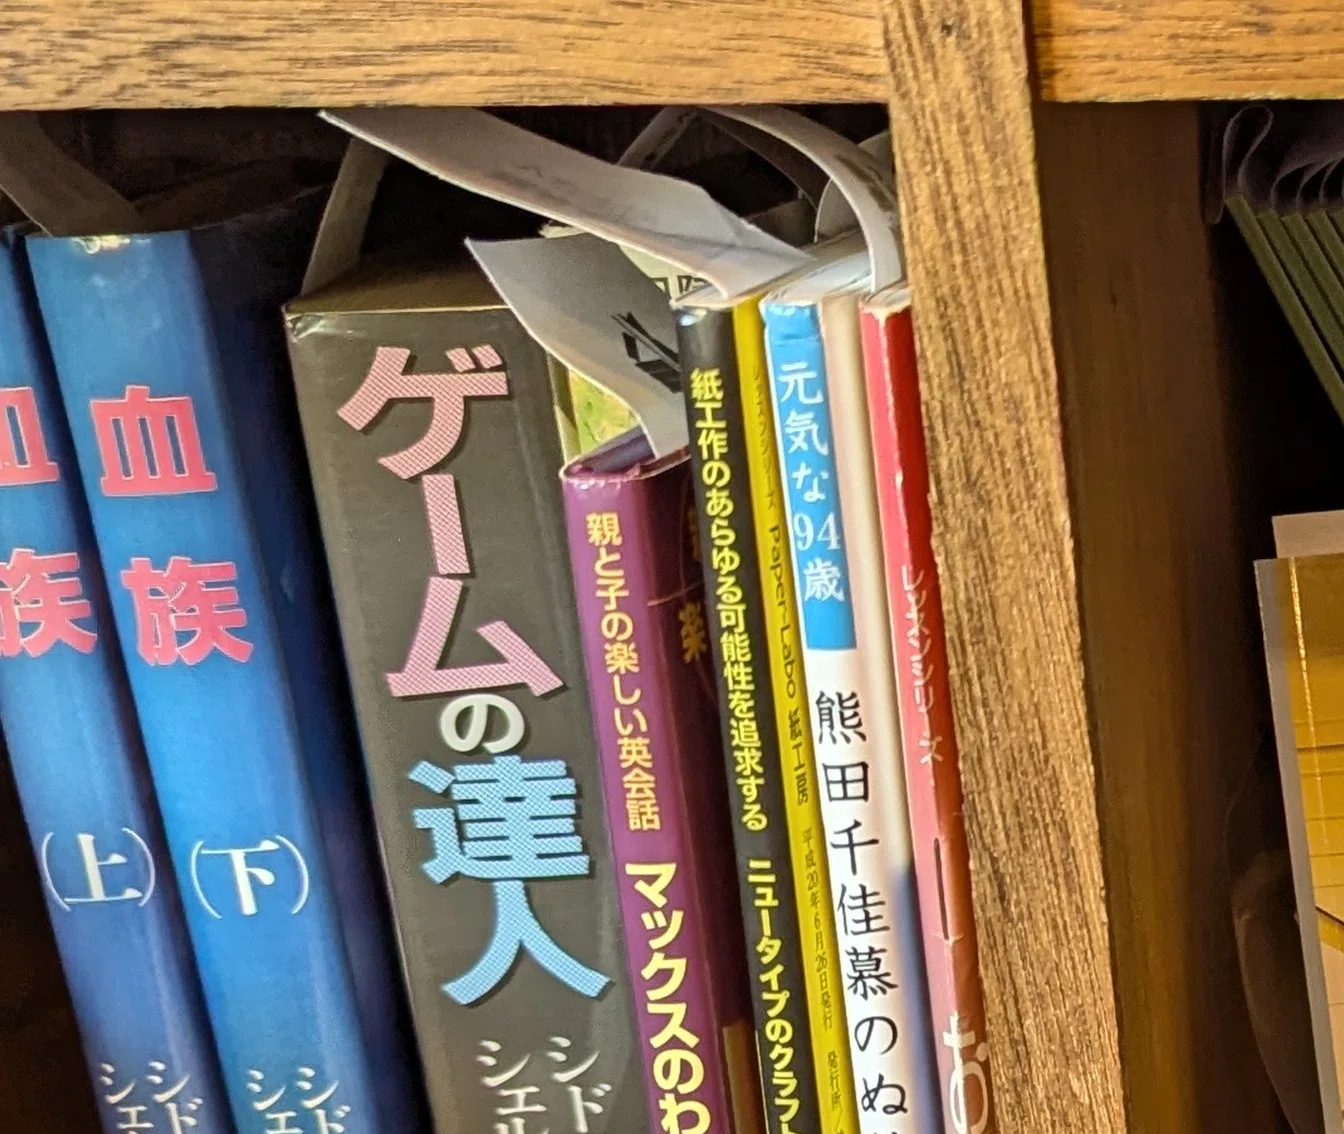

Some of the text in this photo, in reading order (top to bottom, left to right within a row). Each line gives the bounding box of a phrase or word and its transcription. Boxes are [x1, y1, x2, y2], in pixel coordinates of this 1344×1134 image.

[89, 385, 254, 666] 血族
[690, 367, 769, 832] 紙工作のあらゆる可能性を追求する
[778, 361, 846, 602] 元気な94歳
[337, 344, 612, 1005] ゲームの達人
[586, 512, 661, 831] 親と子の楽しい英会話
